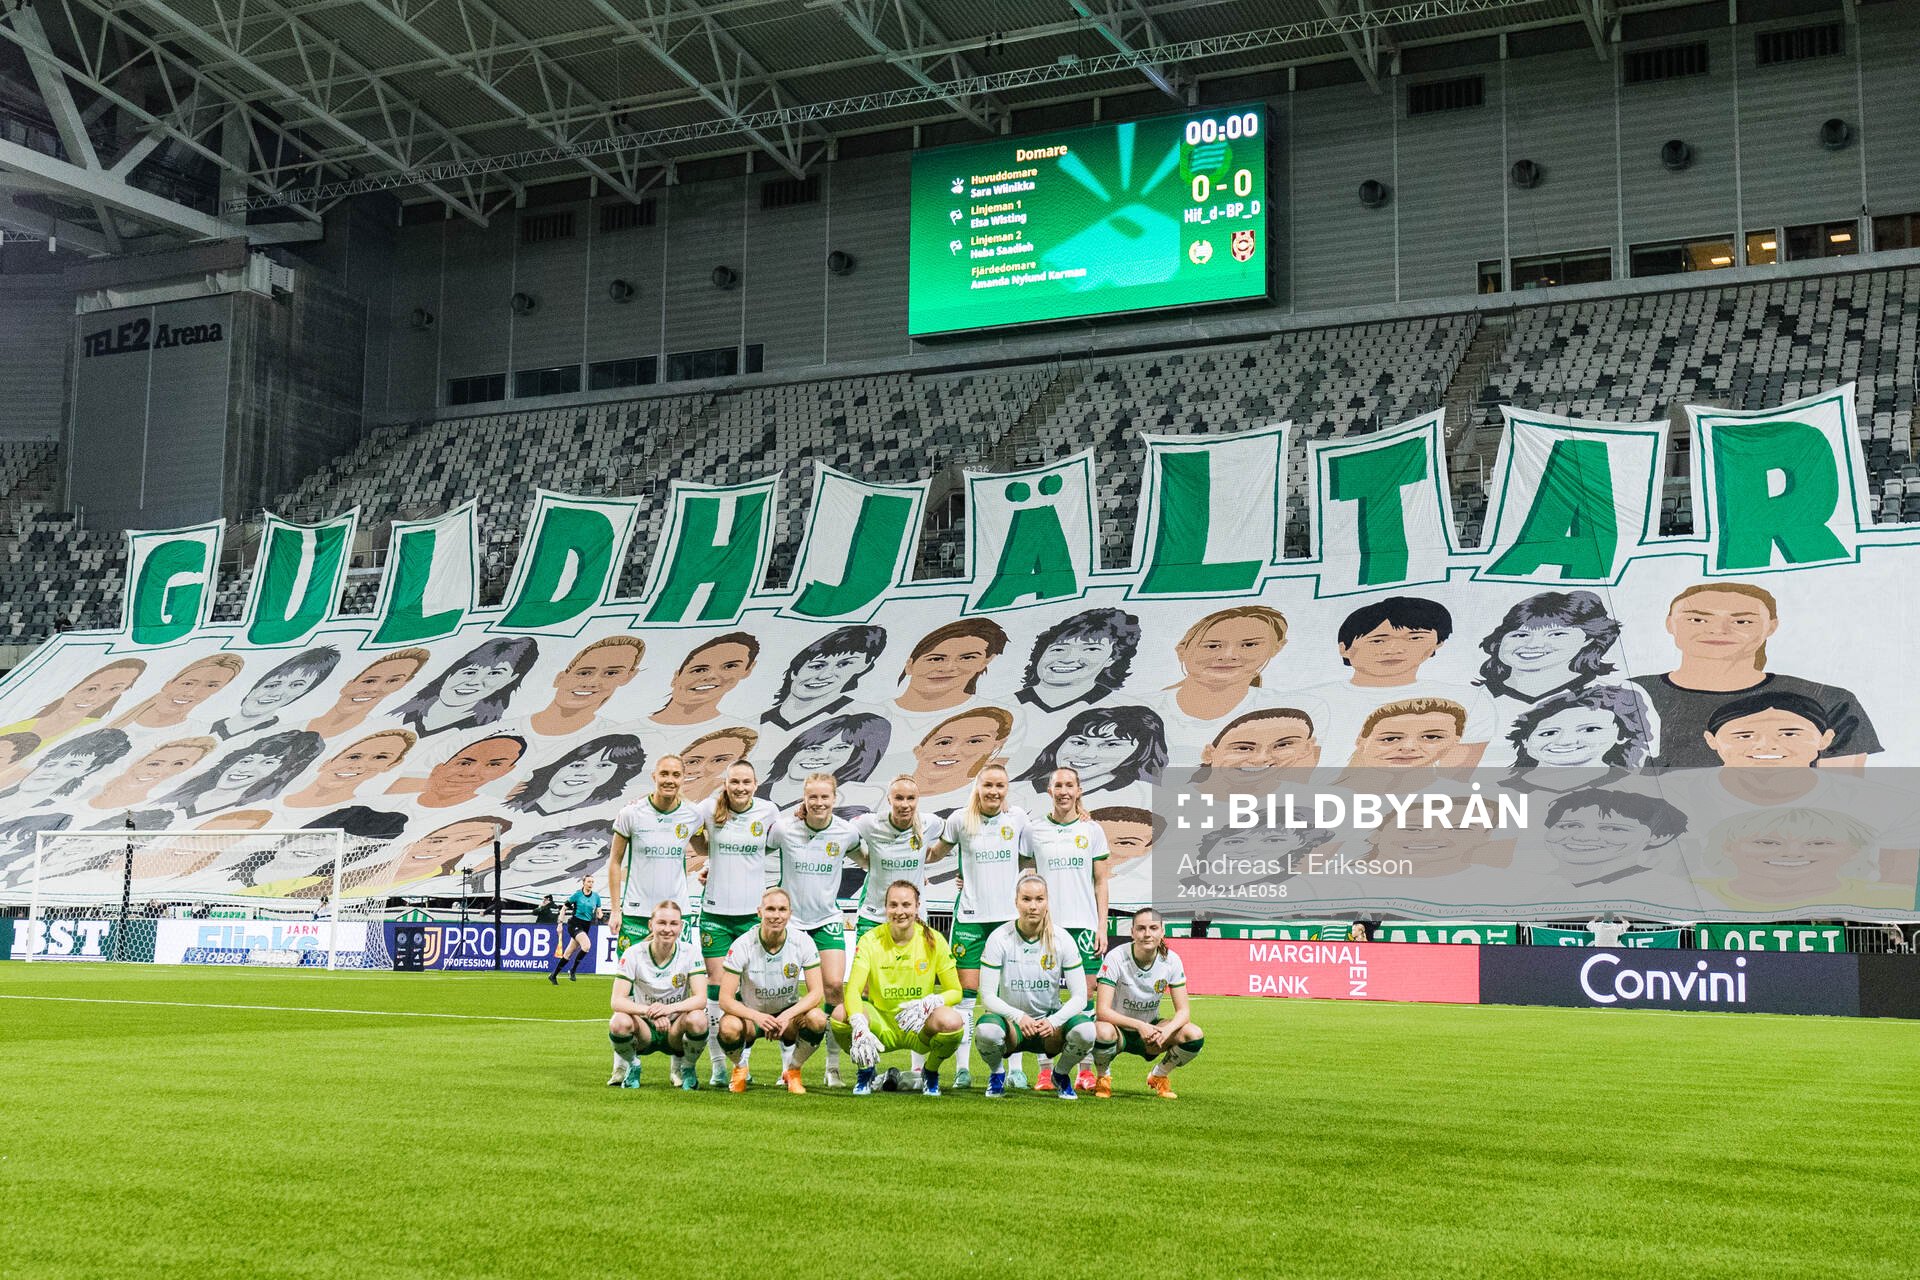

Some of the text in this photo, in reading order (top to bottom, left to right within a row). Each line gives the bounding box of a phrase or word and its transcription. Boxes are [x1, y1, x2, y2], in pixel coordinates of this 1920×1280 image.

[1186, 113, 1258, 145] 00:00
[1016, 143, 1068, 162] Domare
[971, 168, 1038, 185] Huvuddomare
[1192, 174, 1210, 203] 0
[1234, 168, 1252, 197] 0
[970, 188, 992, 198] Sara
[971, 200, 1022, 216] Linjeman 1
[991, 213, 1027, 225] Wisting
[971, 231, 1022, 246] Linjeman 2
[971, 261, 1036, 278] Fjärdedomare
[970, 276, 1010, 290] Amanda
[1011, 271, 1047, 286] Nylund
[84, 318, 223, 357] TELE2 Arena
[644, 846, 682, 856] PROJOB
[718, 843, 758, 853] PROJOB
[975, 849, 1011, 861] PROJOB
[795, 863, 833, 873] PROJOB
[881, 858, 919, 868] PROJOB
[1048, 857, 1084, 867] PROJOB
[11, 919, 111, 955] BST
[444, 927, 551, 957] PROJOB
[443, 958, 549, 969] PROFESSIONA WORKWEAR
[1010, 979, 1050, 989] PROJOB
[1249, 974, 1309, 994] BANK
[1581, 953, 1746, 1003] Convini
[755, 985, 794, 996] PROJOB
[884, 987, 922, 997] PROJOB
[1123, 998, 1159, 1009] PROJOB
